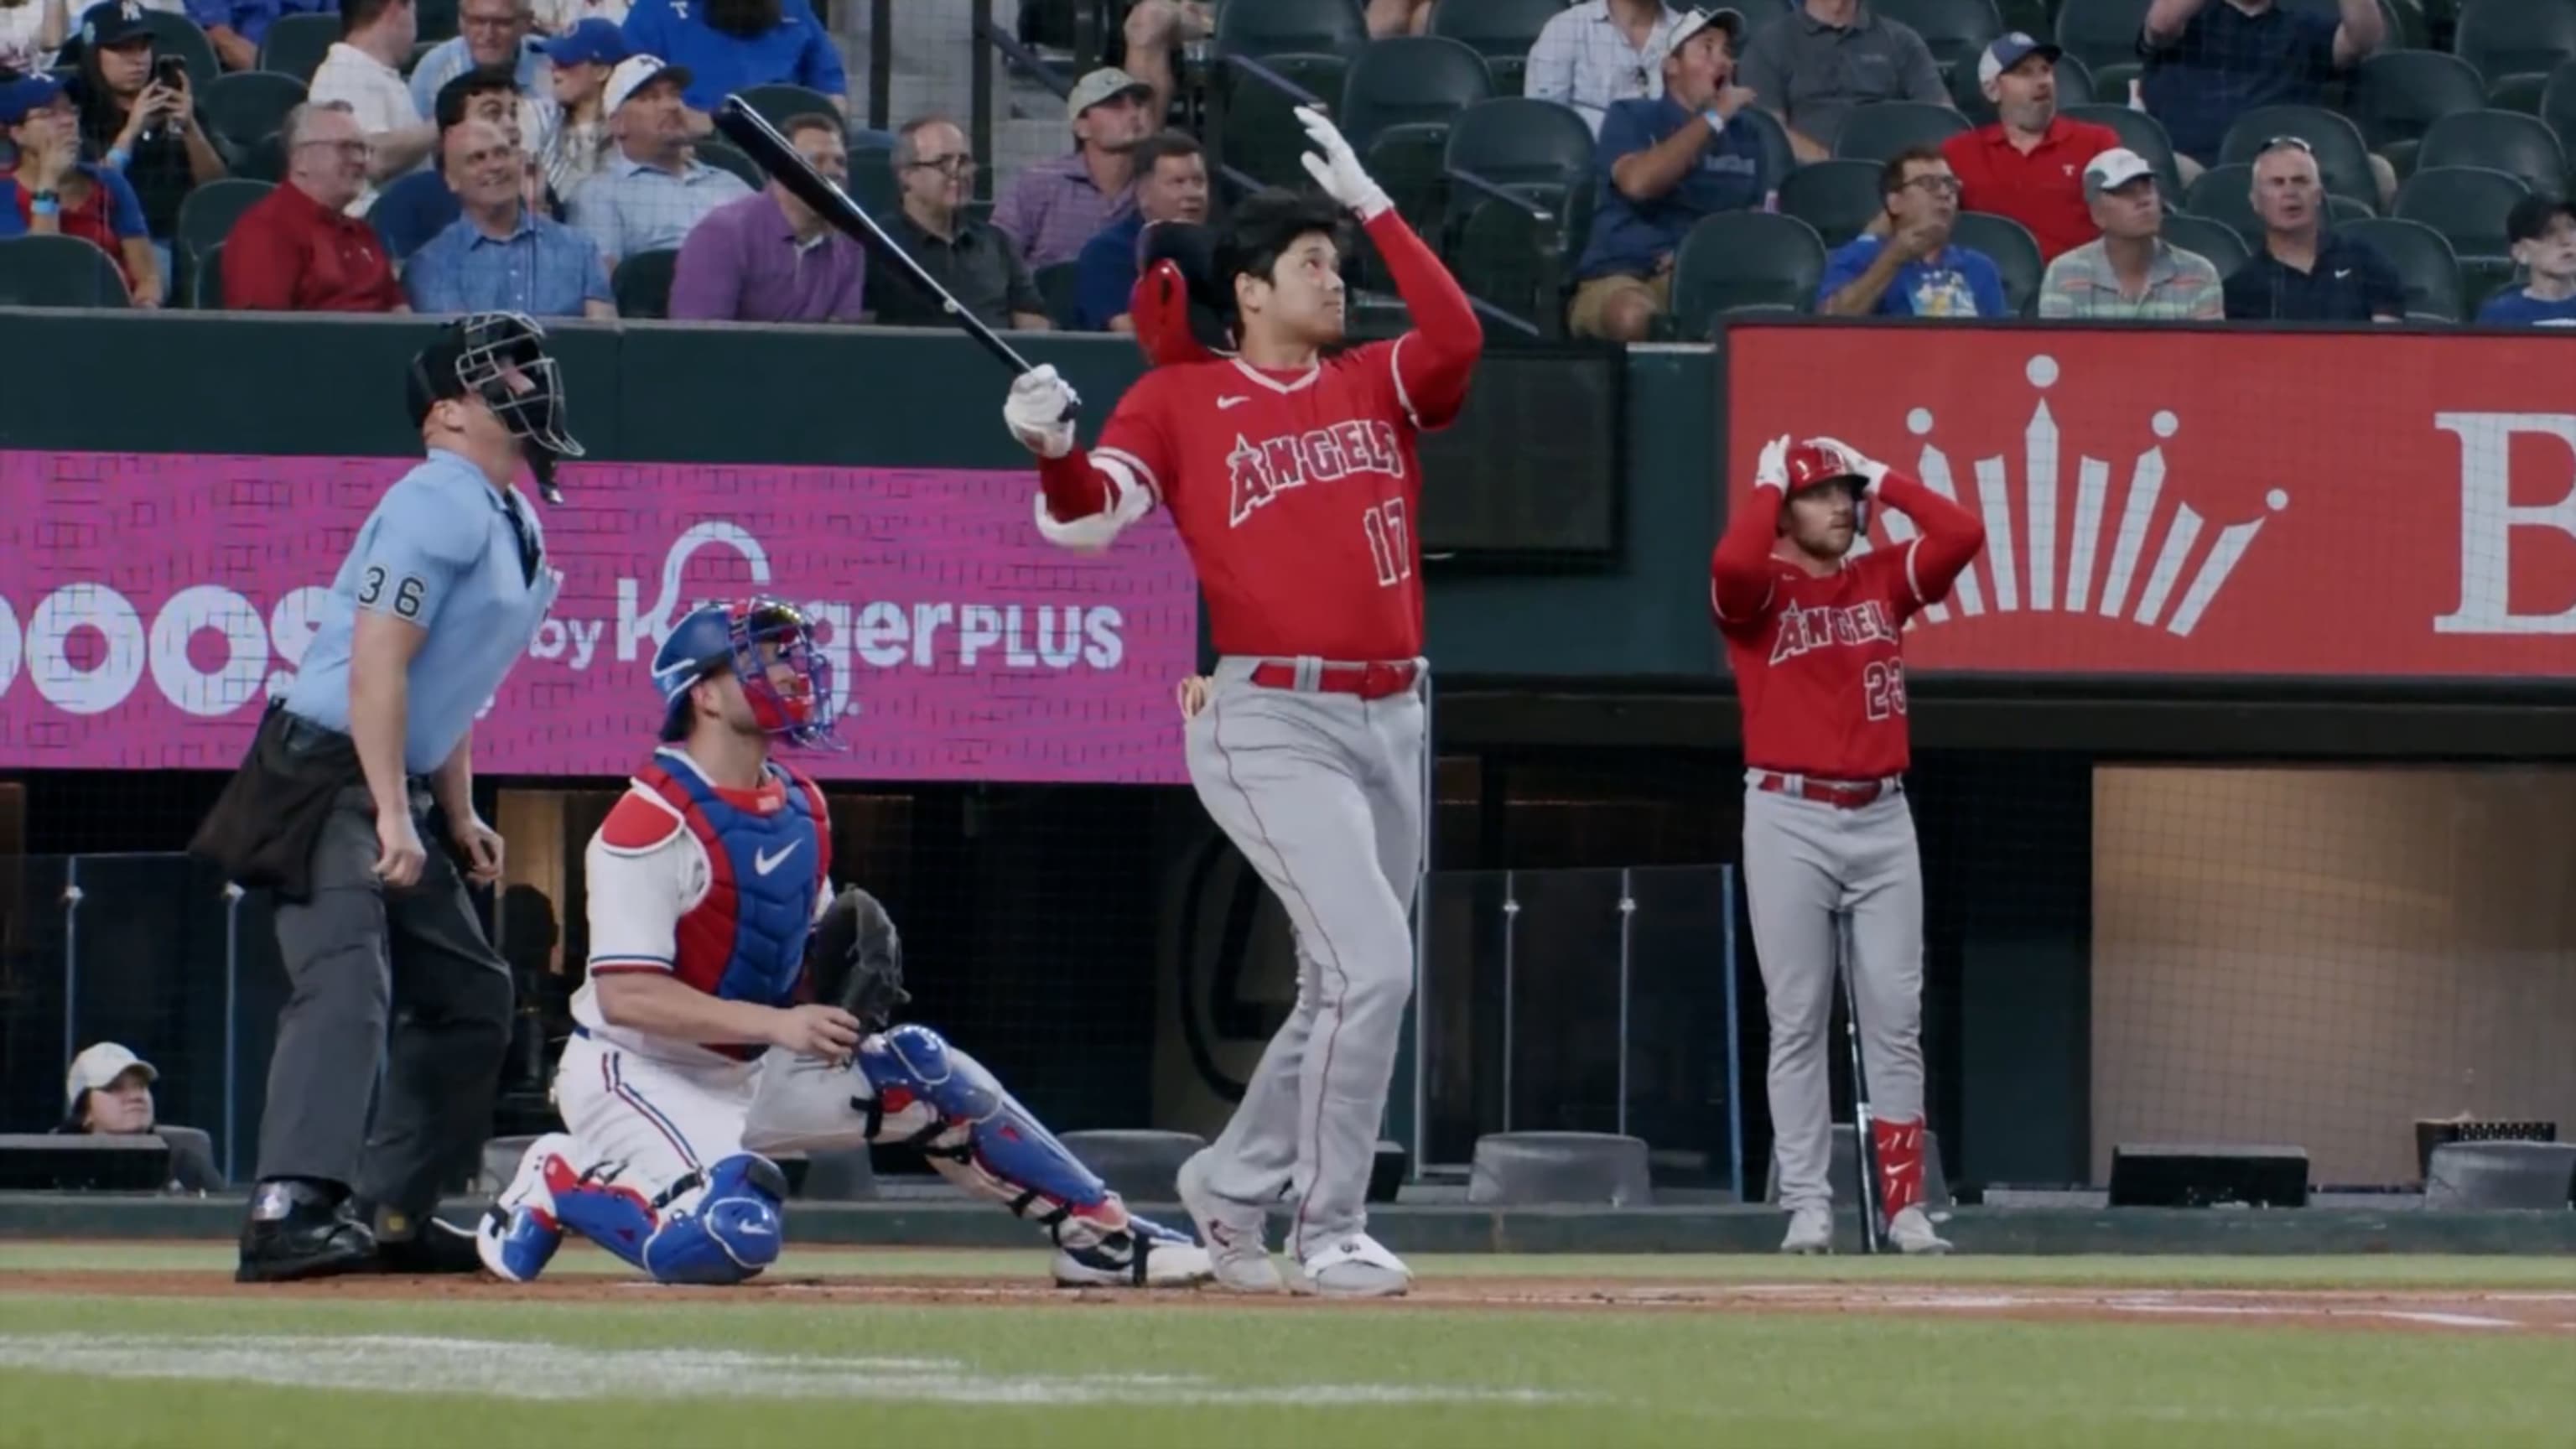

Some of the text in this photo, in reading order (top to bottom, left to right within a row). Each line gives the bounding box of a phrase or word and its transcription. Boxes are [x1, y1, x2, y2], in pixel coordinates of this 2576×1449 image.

[1363, 497, 1410, 586] 17
[358, 566, 425, 618] 36
[965, 605, 1122, 667] PLUS
[1768, 597, 1898, 666] ANGEL
